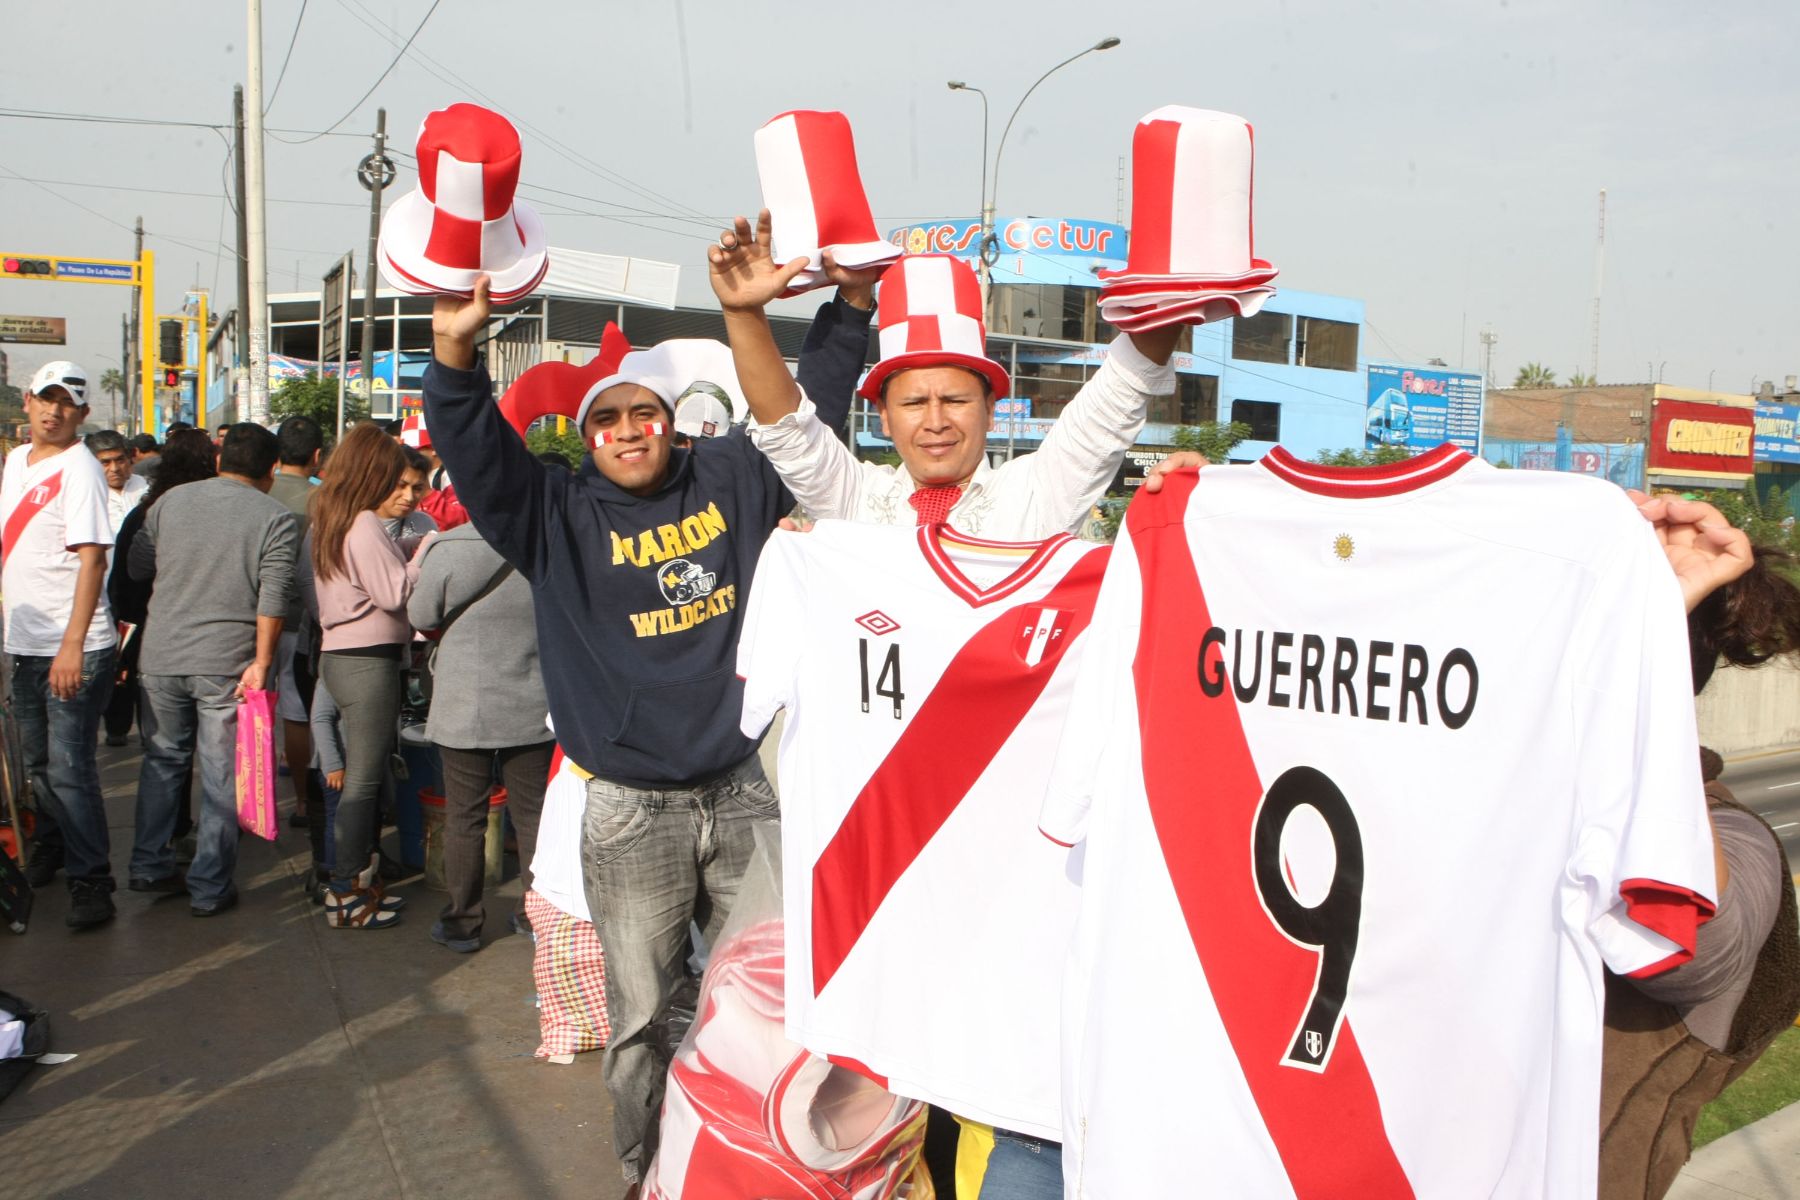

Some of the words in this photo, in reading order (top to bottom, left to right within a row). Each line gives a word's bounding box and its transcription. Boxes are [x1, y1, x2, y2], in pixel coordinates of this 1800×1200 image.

[629, 583, 737, 638] WILDCATS
[858, 638, 905, 720] 14
[1197, 626, 1479, 730] GUERRERO
[1252, 765, 1365, 1070] 9
